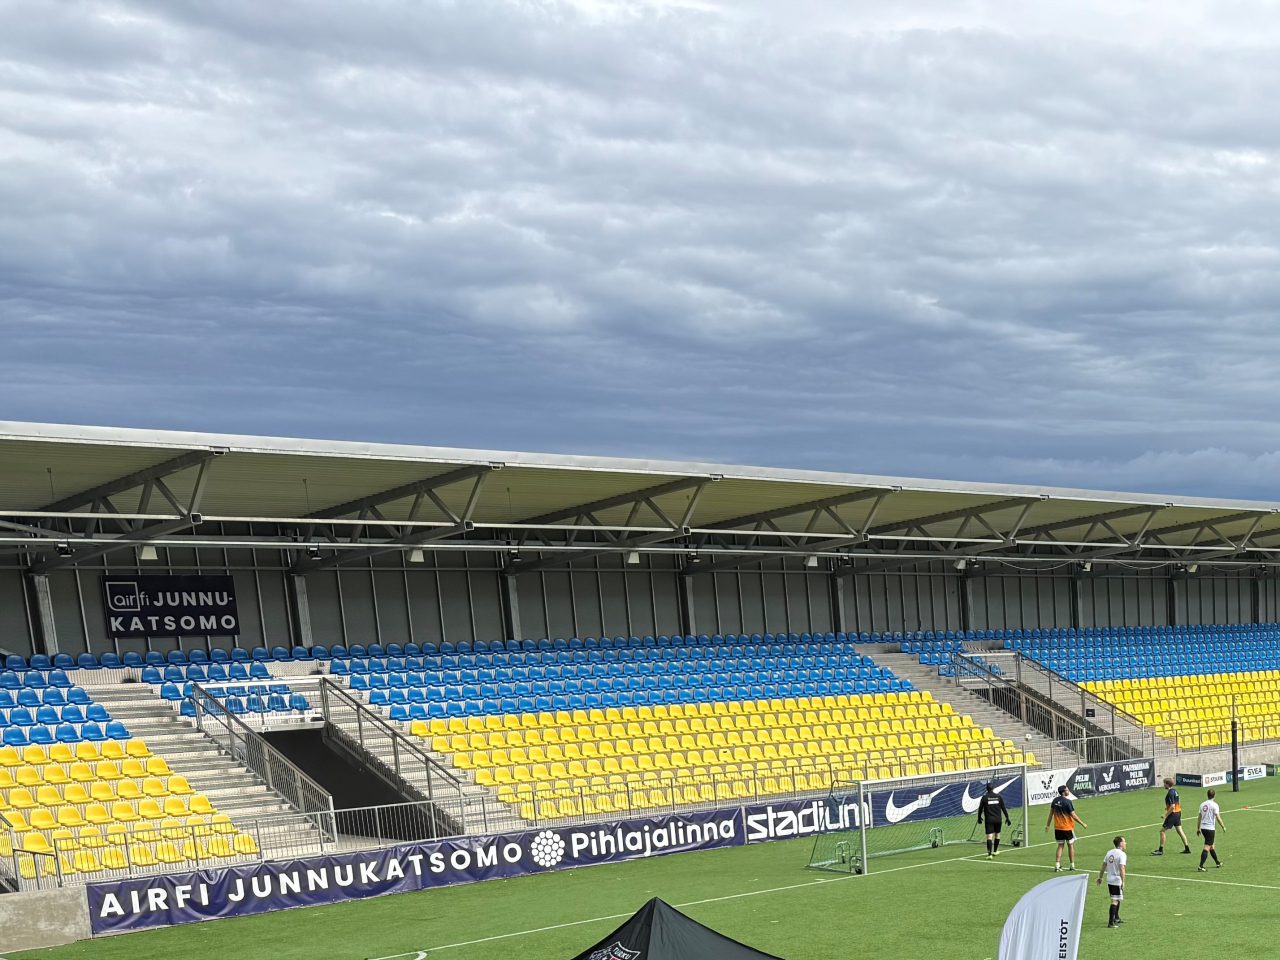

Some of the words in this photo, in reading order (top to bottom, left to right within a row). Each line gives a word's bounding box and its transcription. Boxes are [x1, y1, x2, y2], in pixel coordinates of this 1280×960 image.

[153, 591, 233, 607] JUNNU-
[110, 615, 236, 632] KATSOMO
[1030, 790, 1059, 801] VEDONLYÖ
[747, 800, 871, 841] stadium
[571, 818, 736, 859] Pihlajalinna
[100, 883, 210, 918] AIRFI
[228, 842, 524, 902] JUNNUKATSOMO
